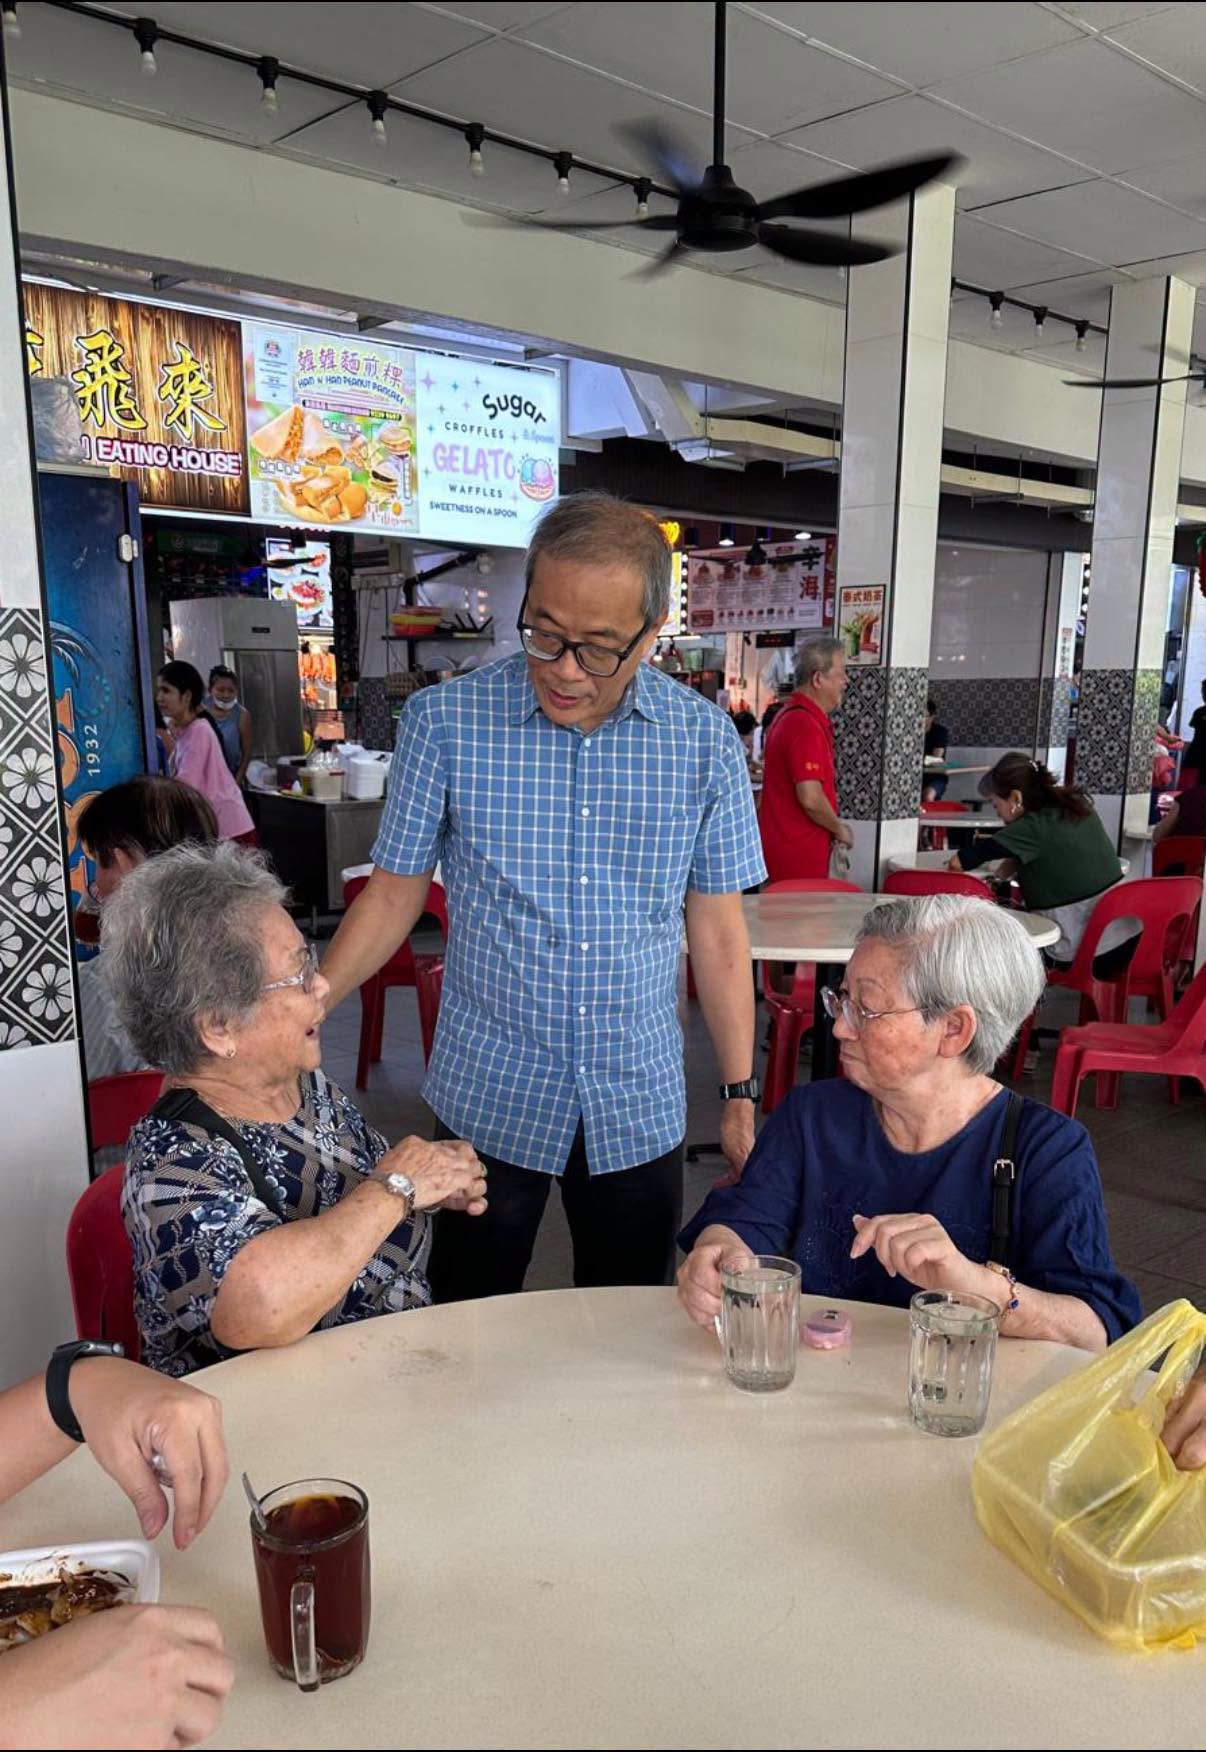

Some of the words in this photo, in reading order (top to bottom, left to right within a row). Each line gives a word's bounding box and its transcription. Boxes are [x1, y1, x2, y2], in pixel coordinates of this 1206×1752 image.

[482, 393, 547, 424] Sugar
[444, 421, 505, 439] CROFFLES
[97, 438, 169, 467] EATING
[172, 447, 240, 475] HOUSE
[433, 442, 516, 481] GELATO
[449, 484, 503, 499] WAFFLES
[429, 501, 474, 515] SWEETNESS
[474, 505, 486, 515] ON
[487, 506, 493, 516] A
[493, 507, 518, 519] SPOON
[84, 723, 100, 777] 1932
